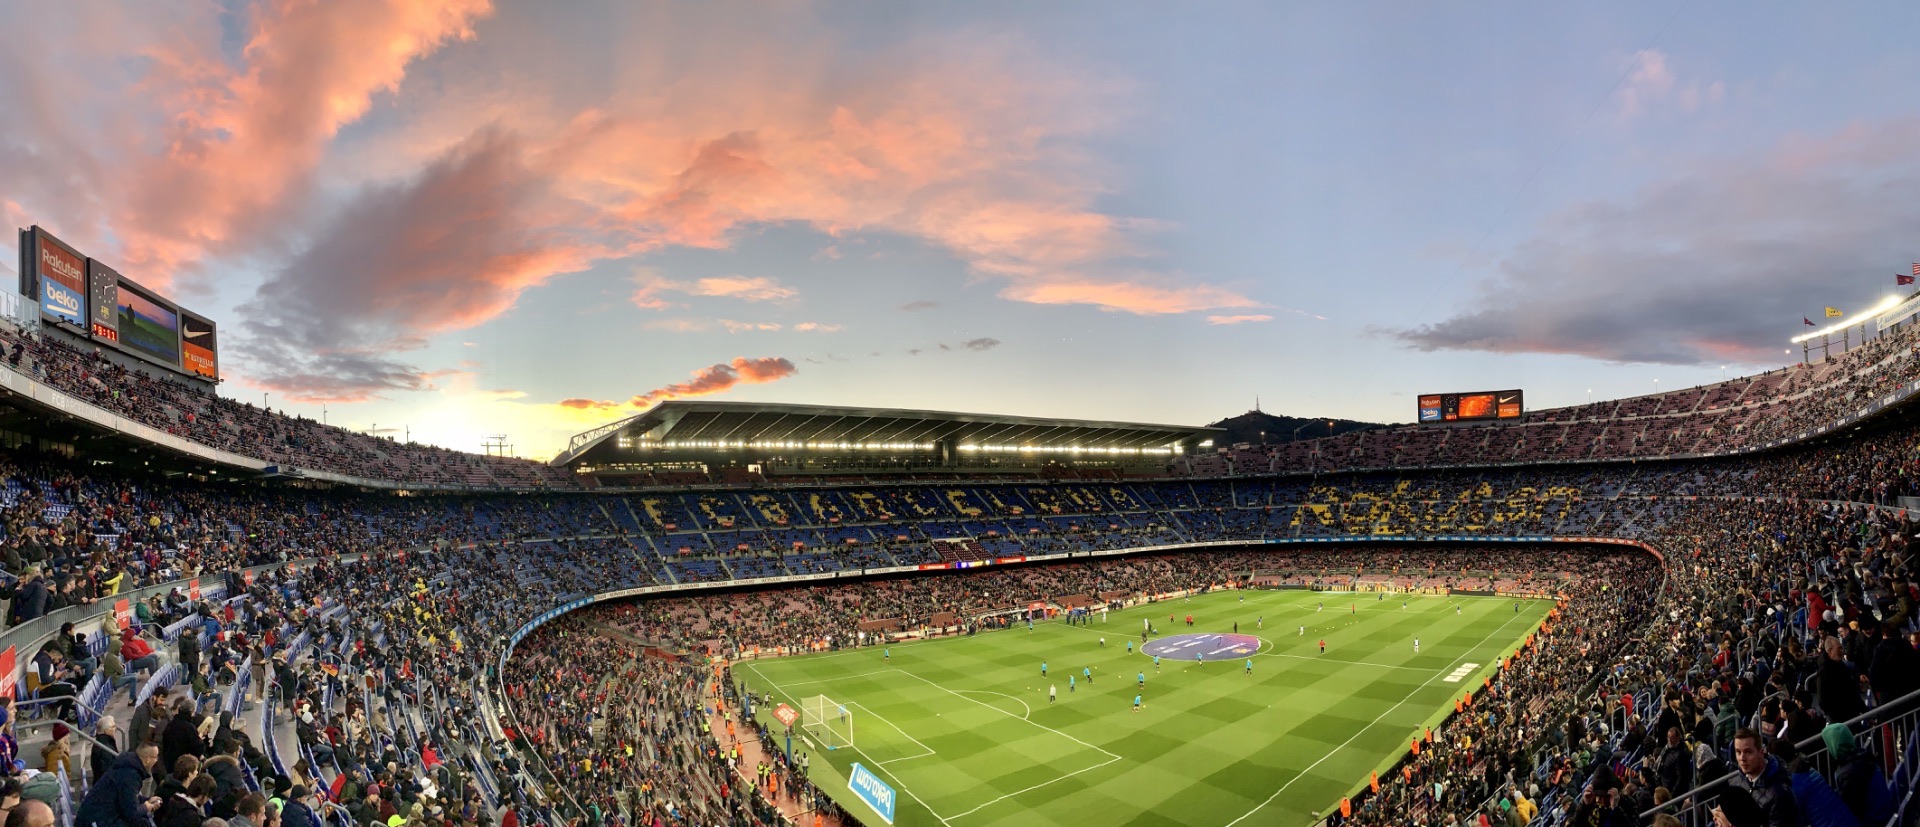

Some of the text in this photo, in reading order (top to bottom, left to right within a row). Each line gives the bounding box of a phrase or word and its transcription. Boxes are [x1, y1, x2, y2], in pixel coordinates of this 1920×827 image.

[43, 248, 82, 282] Rakuten
[46, 281, 79, 311] beko
[190, 353, 214, 367] ESTRELLA
[856, 767, 891, 815] beko.com
